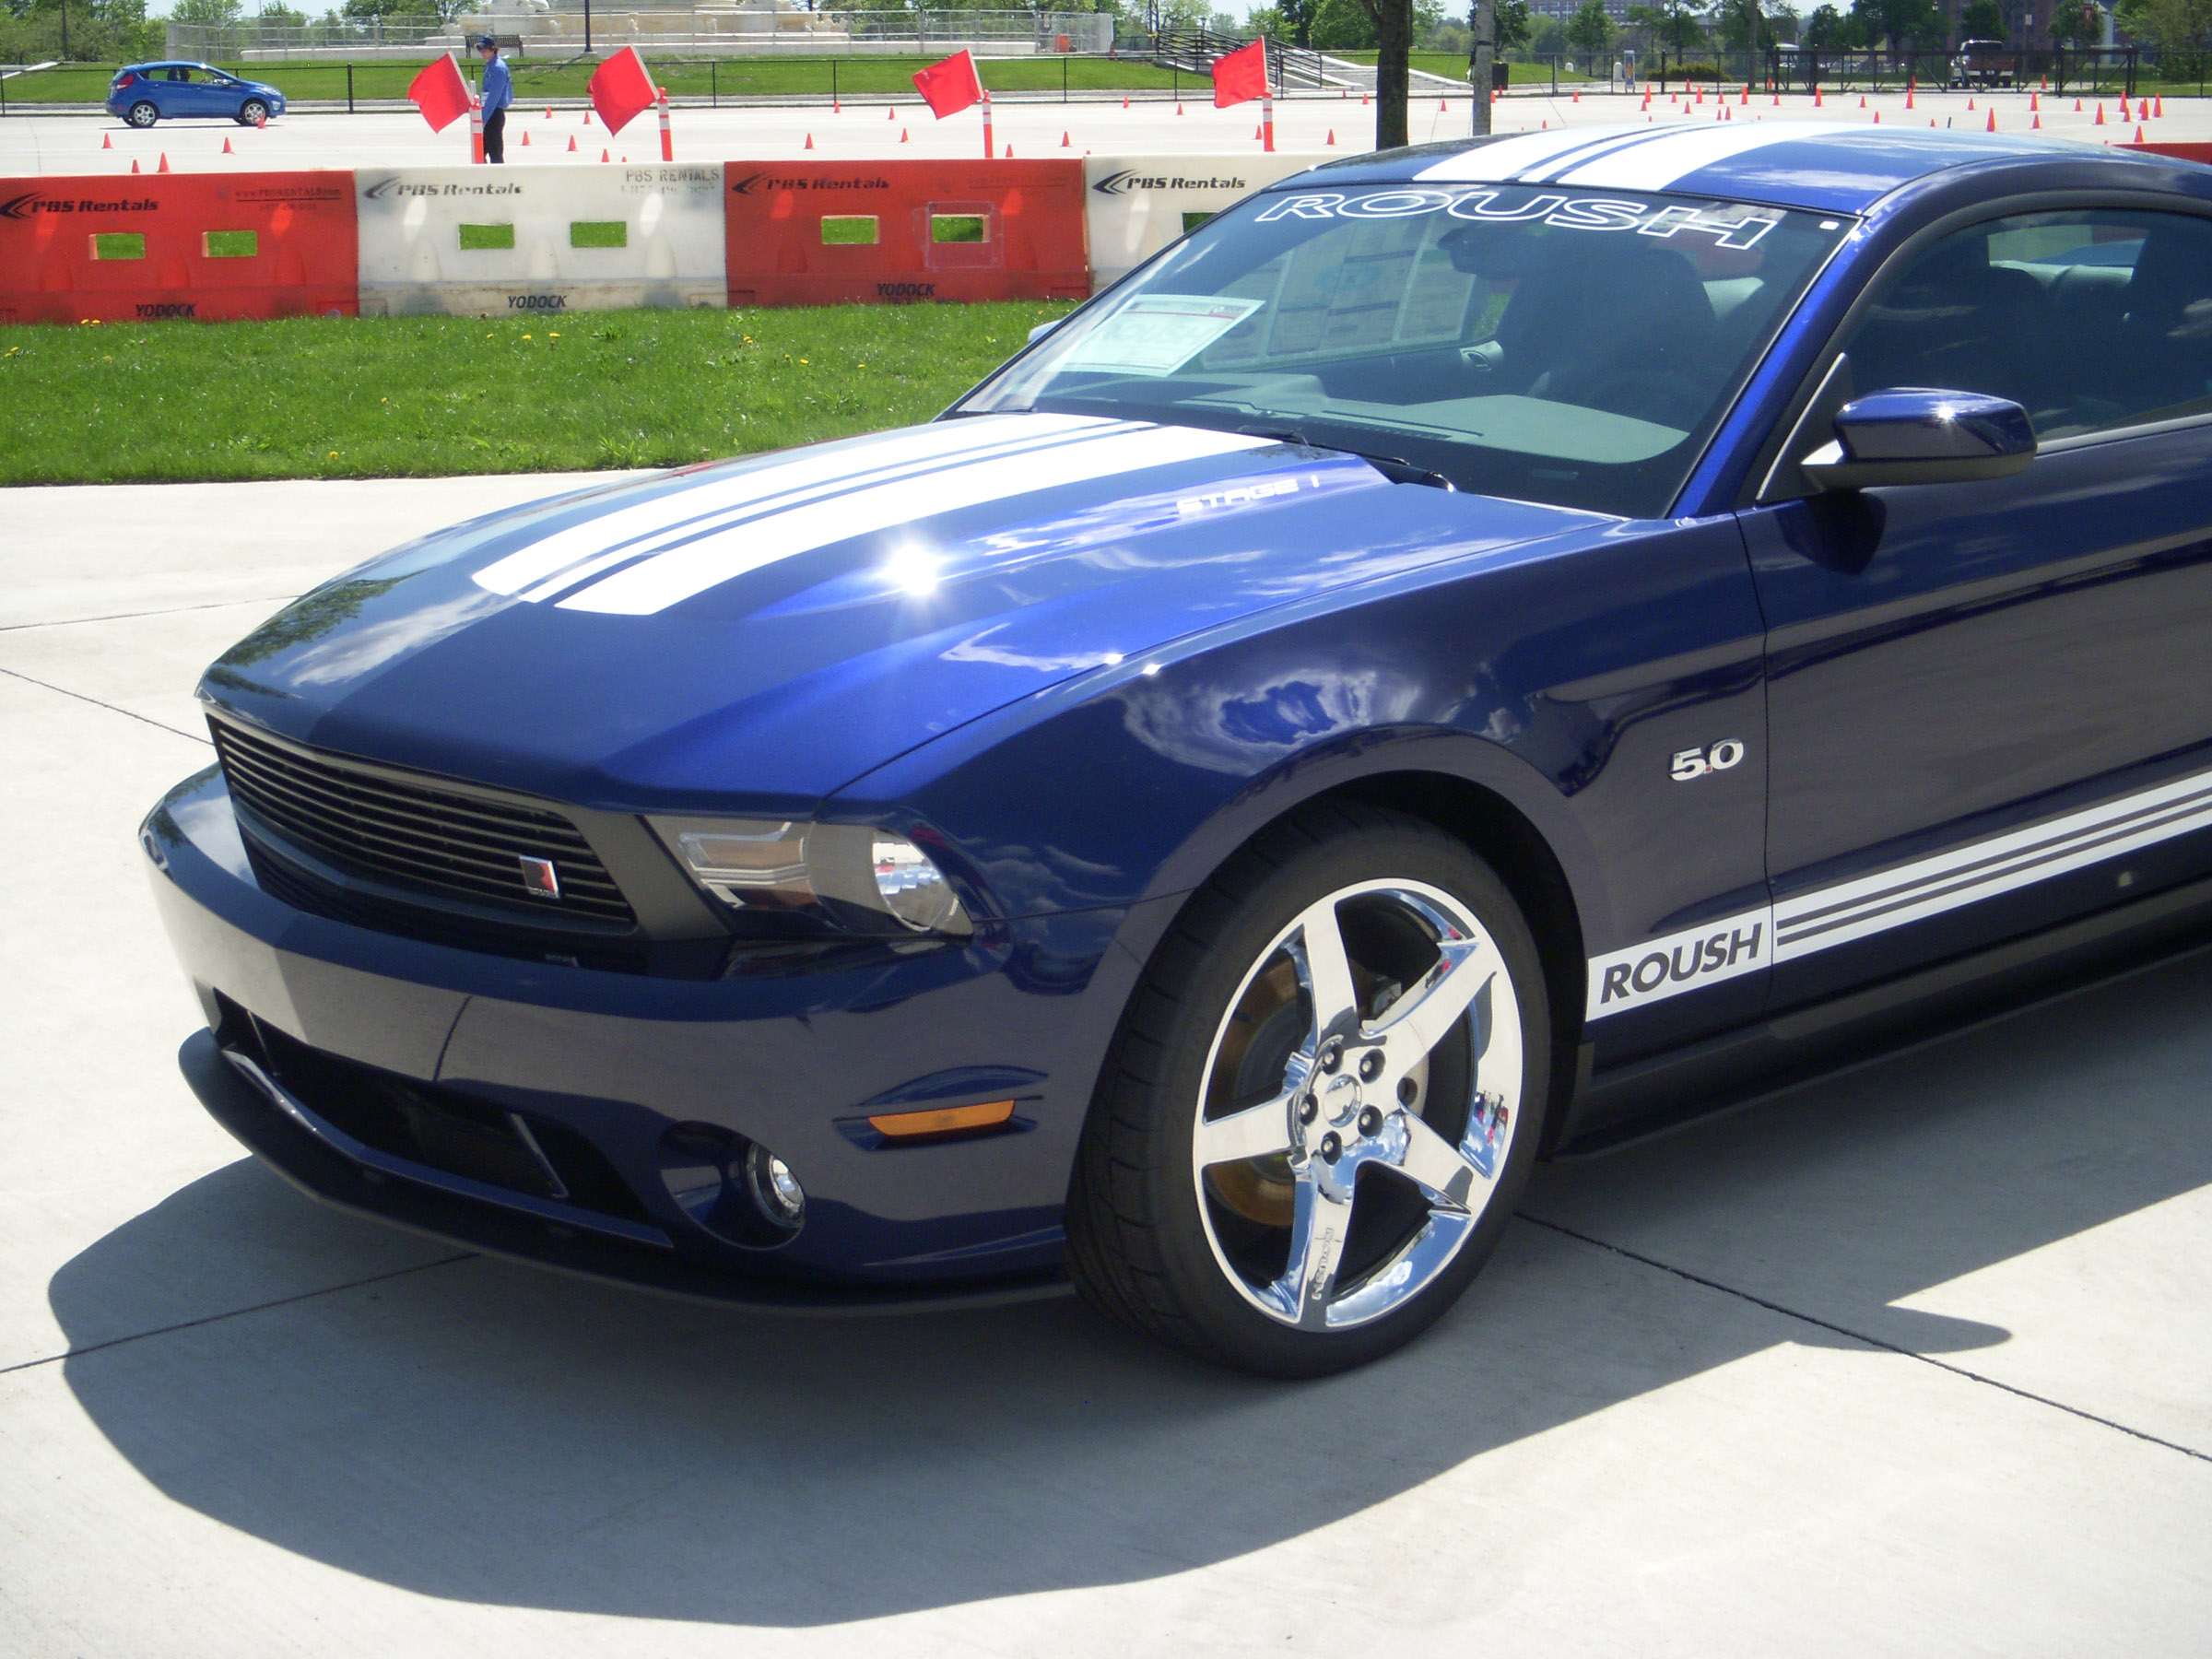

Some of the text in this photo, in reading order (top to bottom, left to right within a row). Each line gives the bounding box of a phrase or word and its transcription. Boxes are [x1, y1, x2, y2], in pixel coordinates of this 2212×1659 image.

[626, 169, 720, 182] PBS RENTALS
[1126, 176, 1246, 190] PBS Rentals
[78, 198, 159, 213] Rentals
[1254, 190, 1779, 251] ROUSH
[877, 283, 935, 297] YODOCK
[508, 295, 568, 310] YODOCK
[135, 303, 197, 318] YODOCK
[1176, 478, 1300, 514] STAGE
[1670, 737, 1745, 782] 5.0
[1600, 922, 1762, 1005] ROUSH
